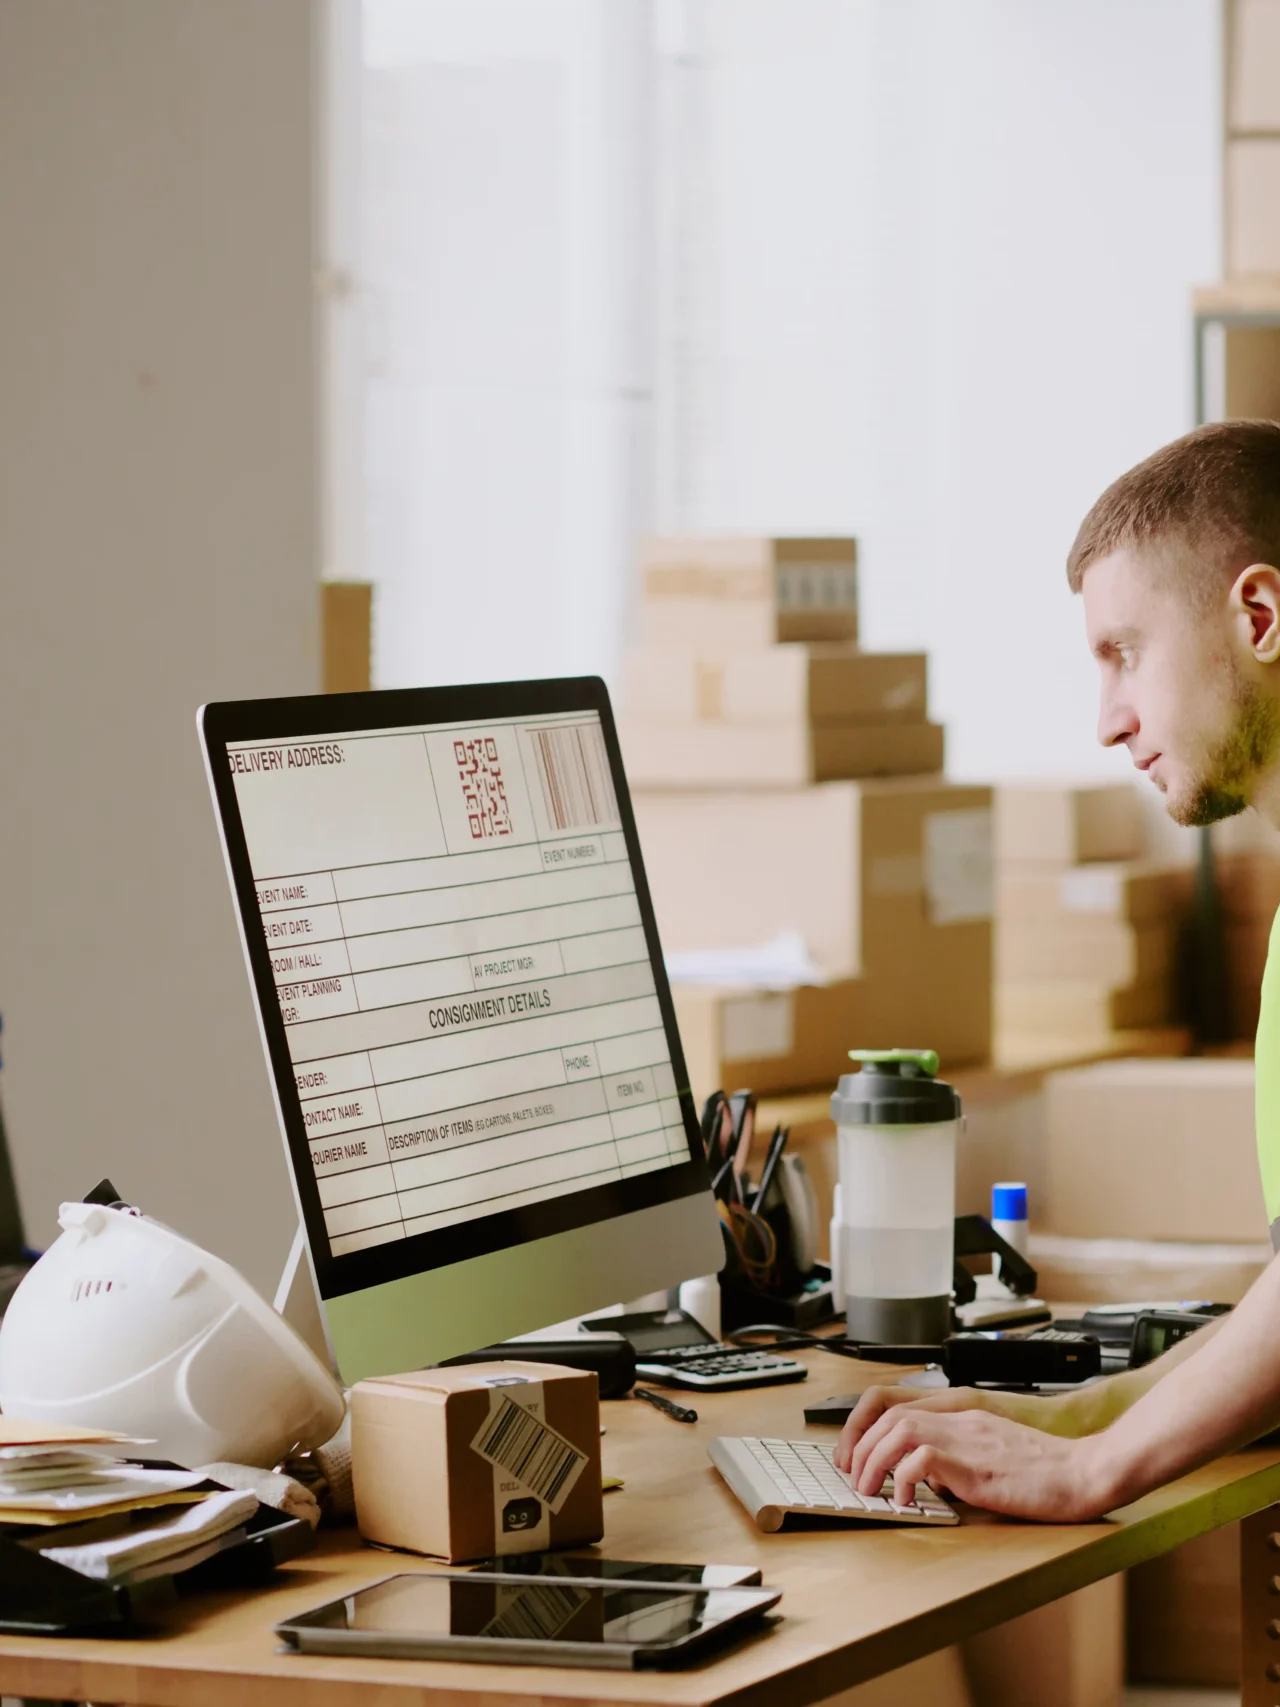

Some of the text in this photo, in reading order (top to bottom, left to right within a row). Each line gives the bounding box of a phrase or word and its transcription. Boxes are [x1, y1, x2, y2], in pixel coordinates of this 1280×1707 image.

[228, 744, 346, 774] DELIVERY ADDRESS:
[544, 848, 566, 864] EVENT
[281, 885, 309, 901] NAME:
[289, 919, 313, 935] DATE:
[299, 953, 323, 969] HALL:
[474, 965, 484, 979] AV
[484, 959, 517, 976] PROJECT
[301, 979, 342, 998] PLANNING
[428, 989, 552, 1029] CONSIGNMENT DETAILS
[296, 1071, 328, 1090] ENDER:
[304, 1102, 364, 1127] ONTACT NAME:
[388, 1128, 440, 1151] DESCRIPTION
[439, 1124, 450, 1139] OF
[450, 1118, 474, 1137] ITEMS
[474, 1118, 486, 1133] (EG
[311, 1141, 368, 1166] OURIER NAME
